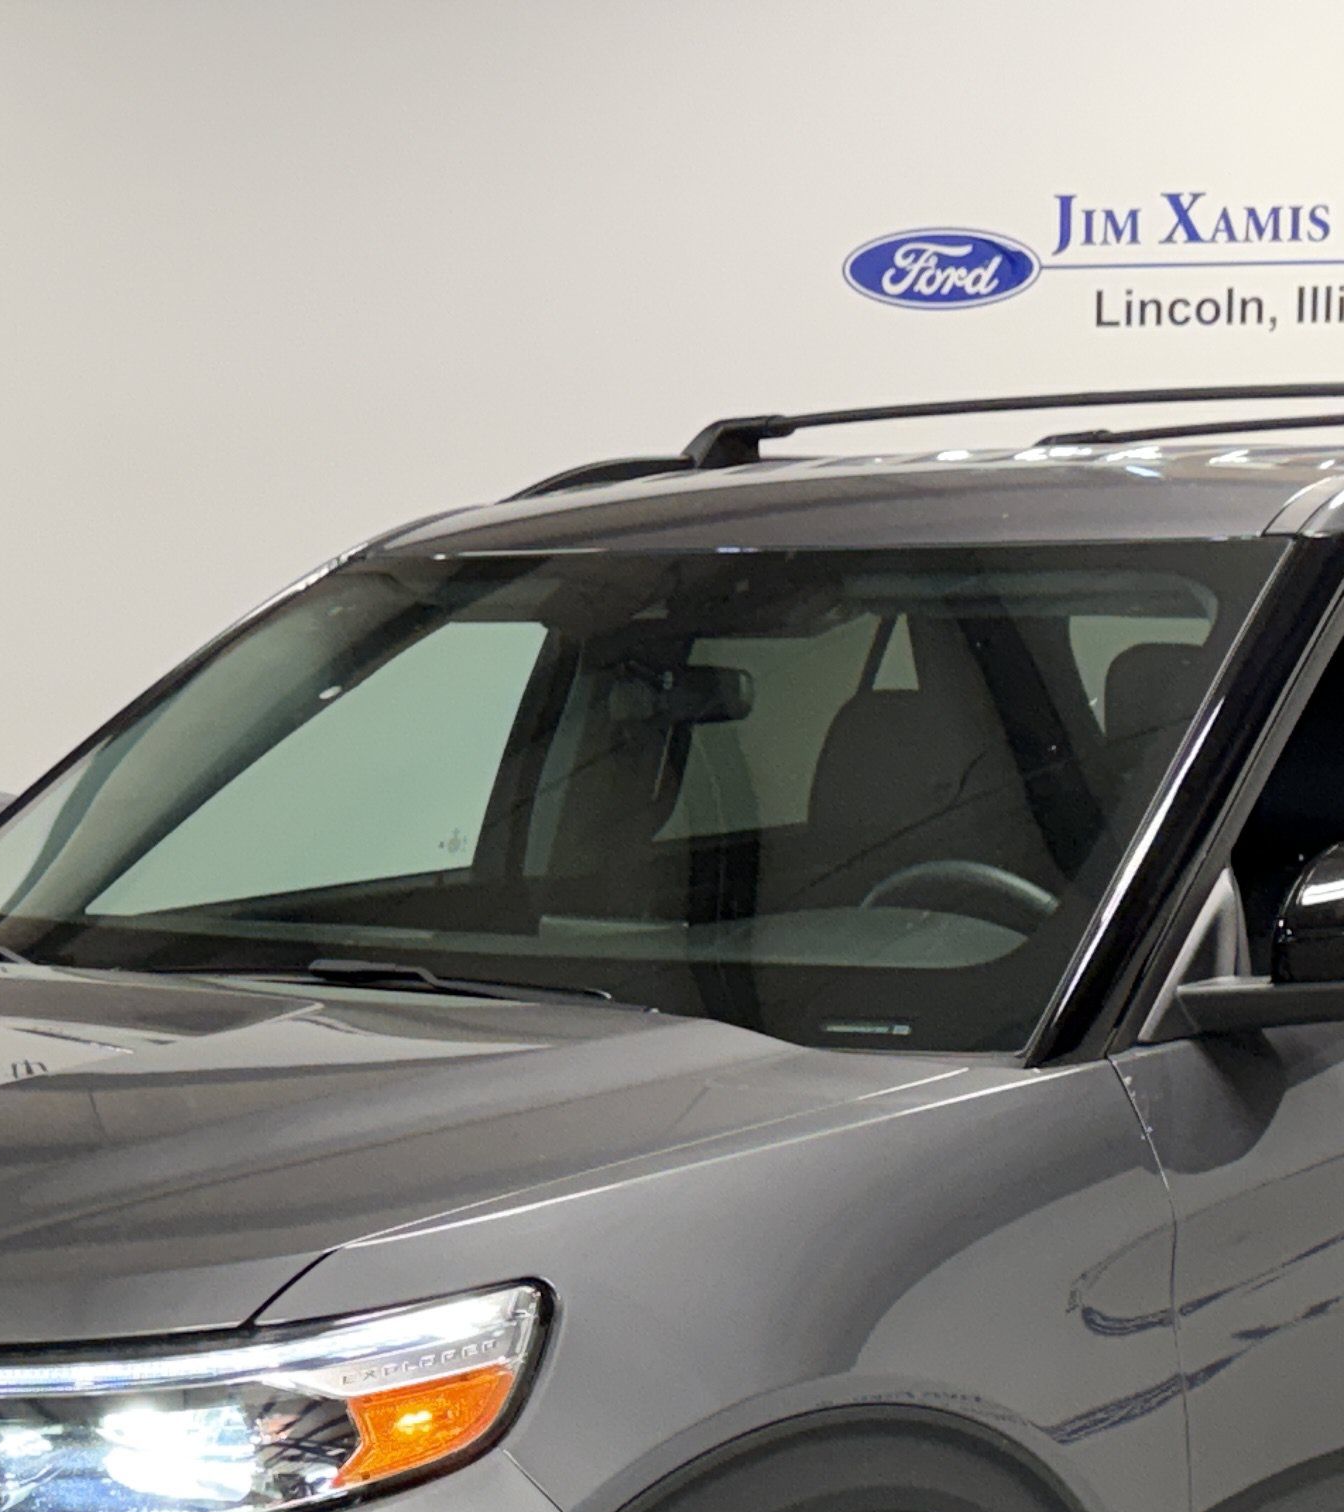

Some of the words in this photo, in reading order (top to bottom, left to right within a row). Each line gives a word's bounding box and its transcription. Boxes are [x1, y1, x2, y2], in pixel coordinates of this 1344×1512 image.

[1052, 194, 1140, 255] JIM
[1159, 191, 1331, 244] XAMIS
[880, 243, 1000, 297] Ford
[1096, 287, 1278, 331] Lincoln,
